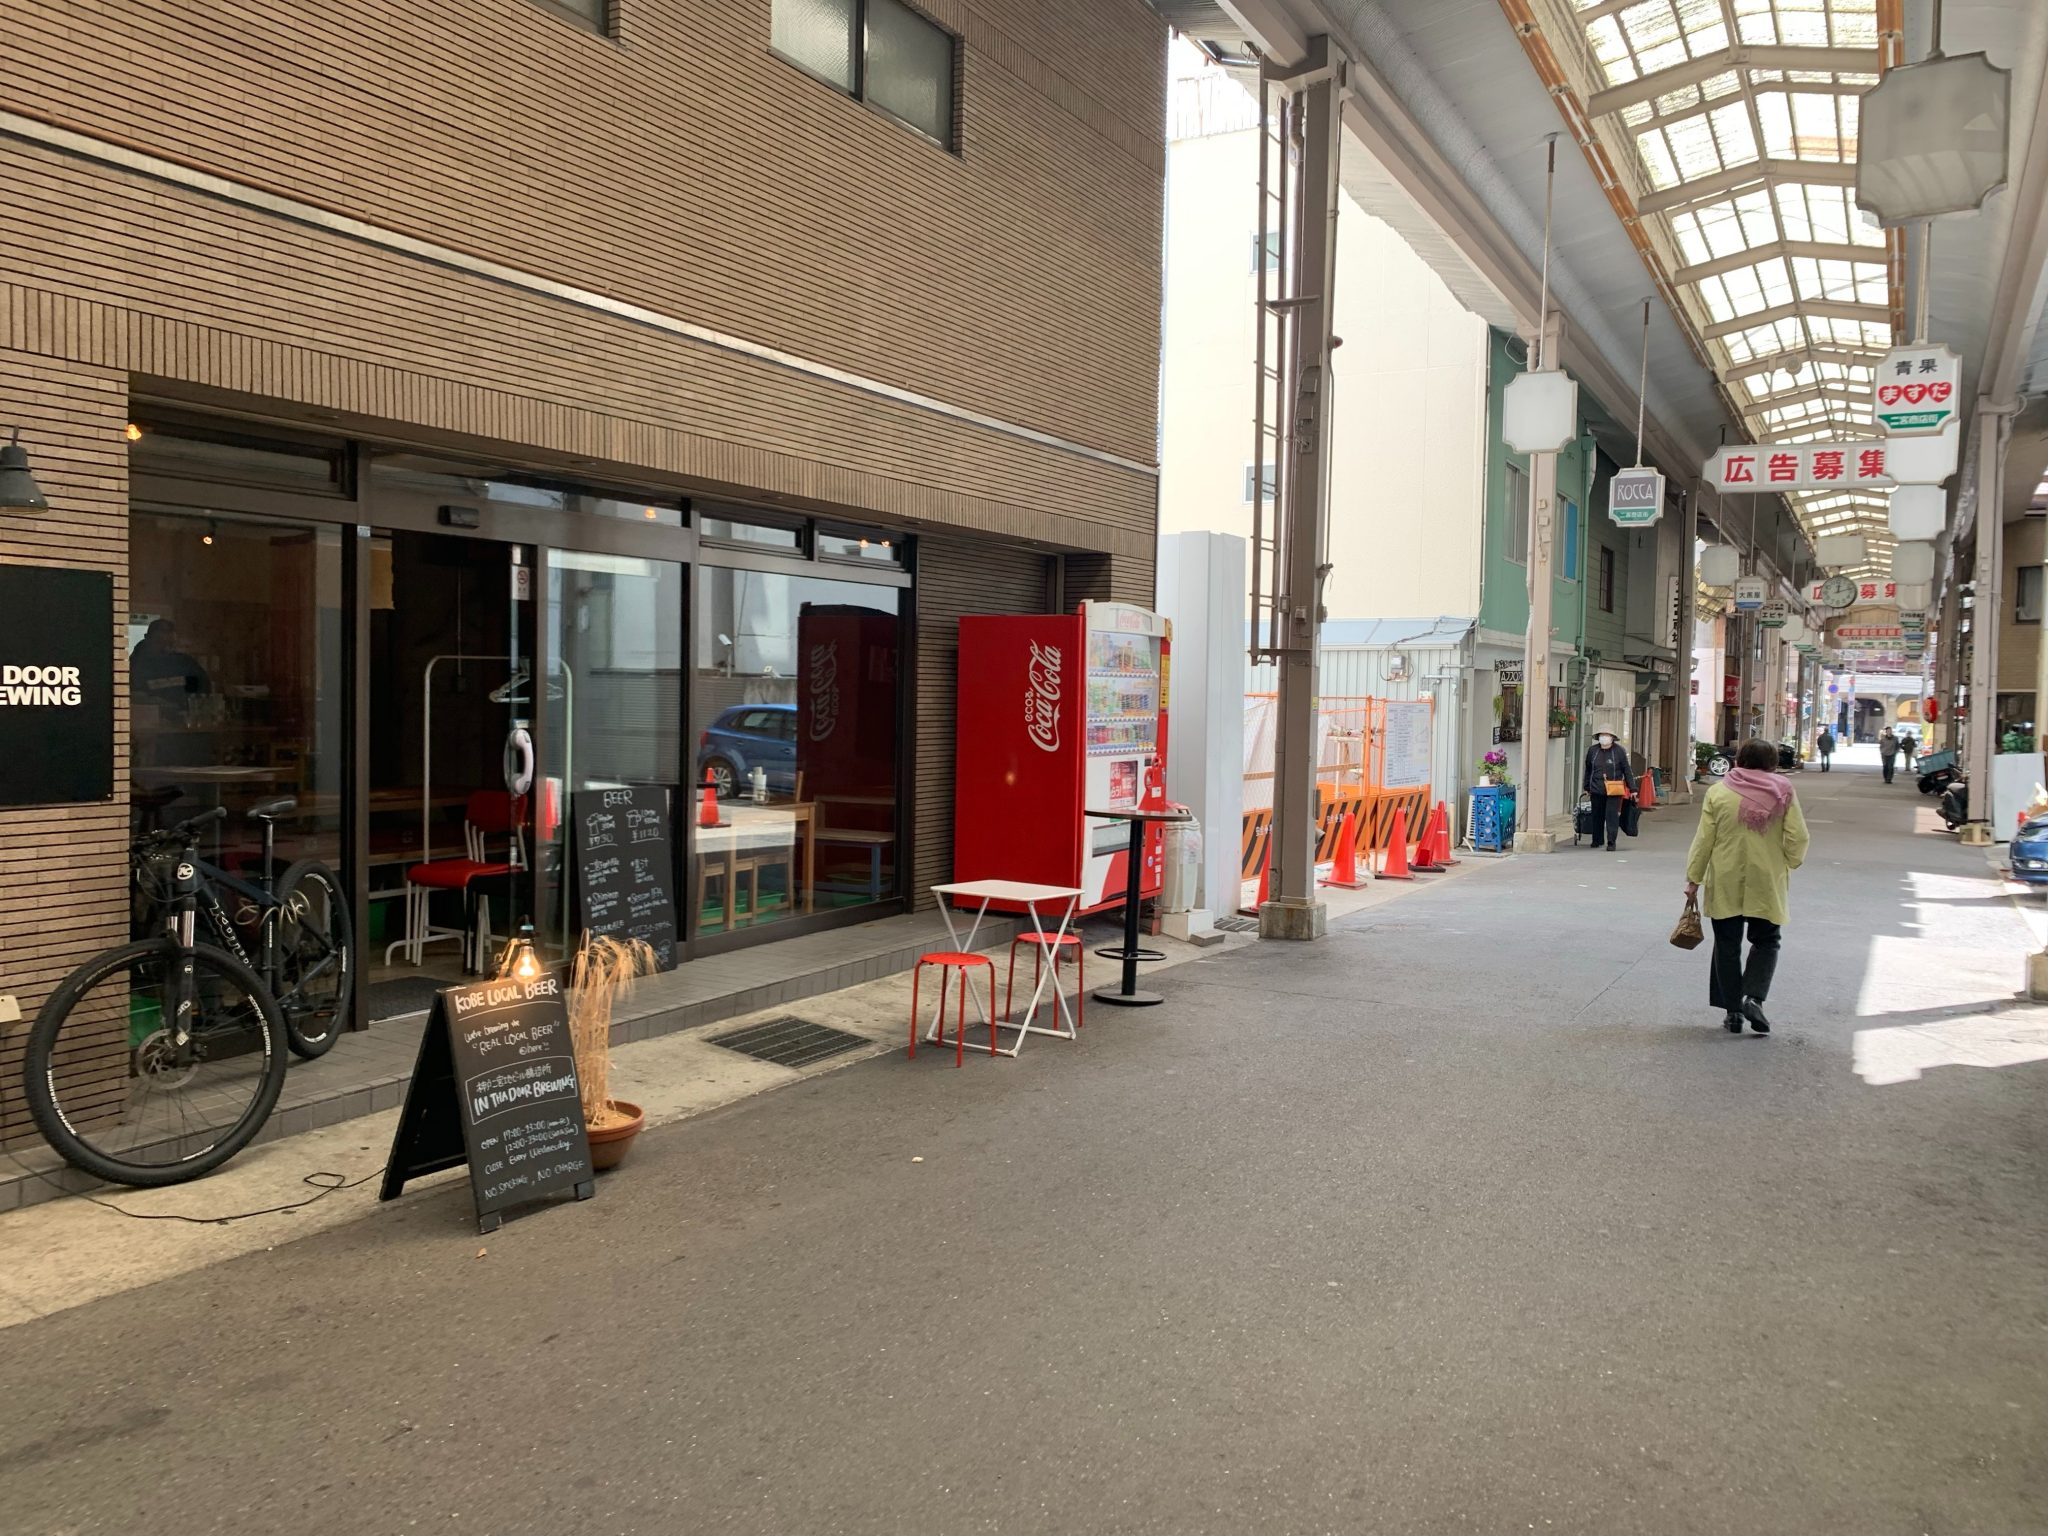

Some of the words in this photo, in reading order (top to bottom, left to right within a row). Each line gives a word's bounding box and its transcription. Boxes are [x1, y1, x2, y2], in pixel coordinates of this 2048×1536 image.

[1895, 358, 1938, 376] 青果
[1881, 382, 1950, 401] ますだ
[1890, 413, 1938, 426] 二宮商店街
[1724, 449, 1885, 483] 広告募集
[1617, 483, 1654, 501] ROCCA
[2, 665, 81, 686] DOOR
[1028, 638, 1062, 752] Coca-Cola
[603, 789, 633, 808] BEER
[454, 991, 485, 1014] KOBE
[487, 984, 522, 1006] LOCAL
[525, 978, 559, 999] BEER
[504, 1031, 529, 1046] LOCAL
[473, 1096, 489, 1116] IN
[490, 1090, 509, 1108] THA
[508, 1084, 533, 1103] DOOR
[533, 1074, 576, 1098] BREWING
[480, 1136, 500, 1150] OPEN
[484, 1186, 497, 1200] NO
[537, 1168, 551, 1182] NO
[554, 1160, 585, 1174] CHARGE
